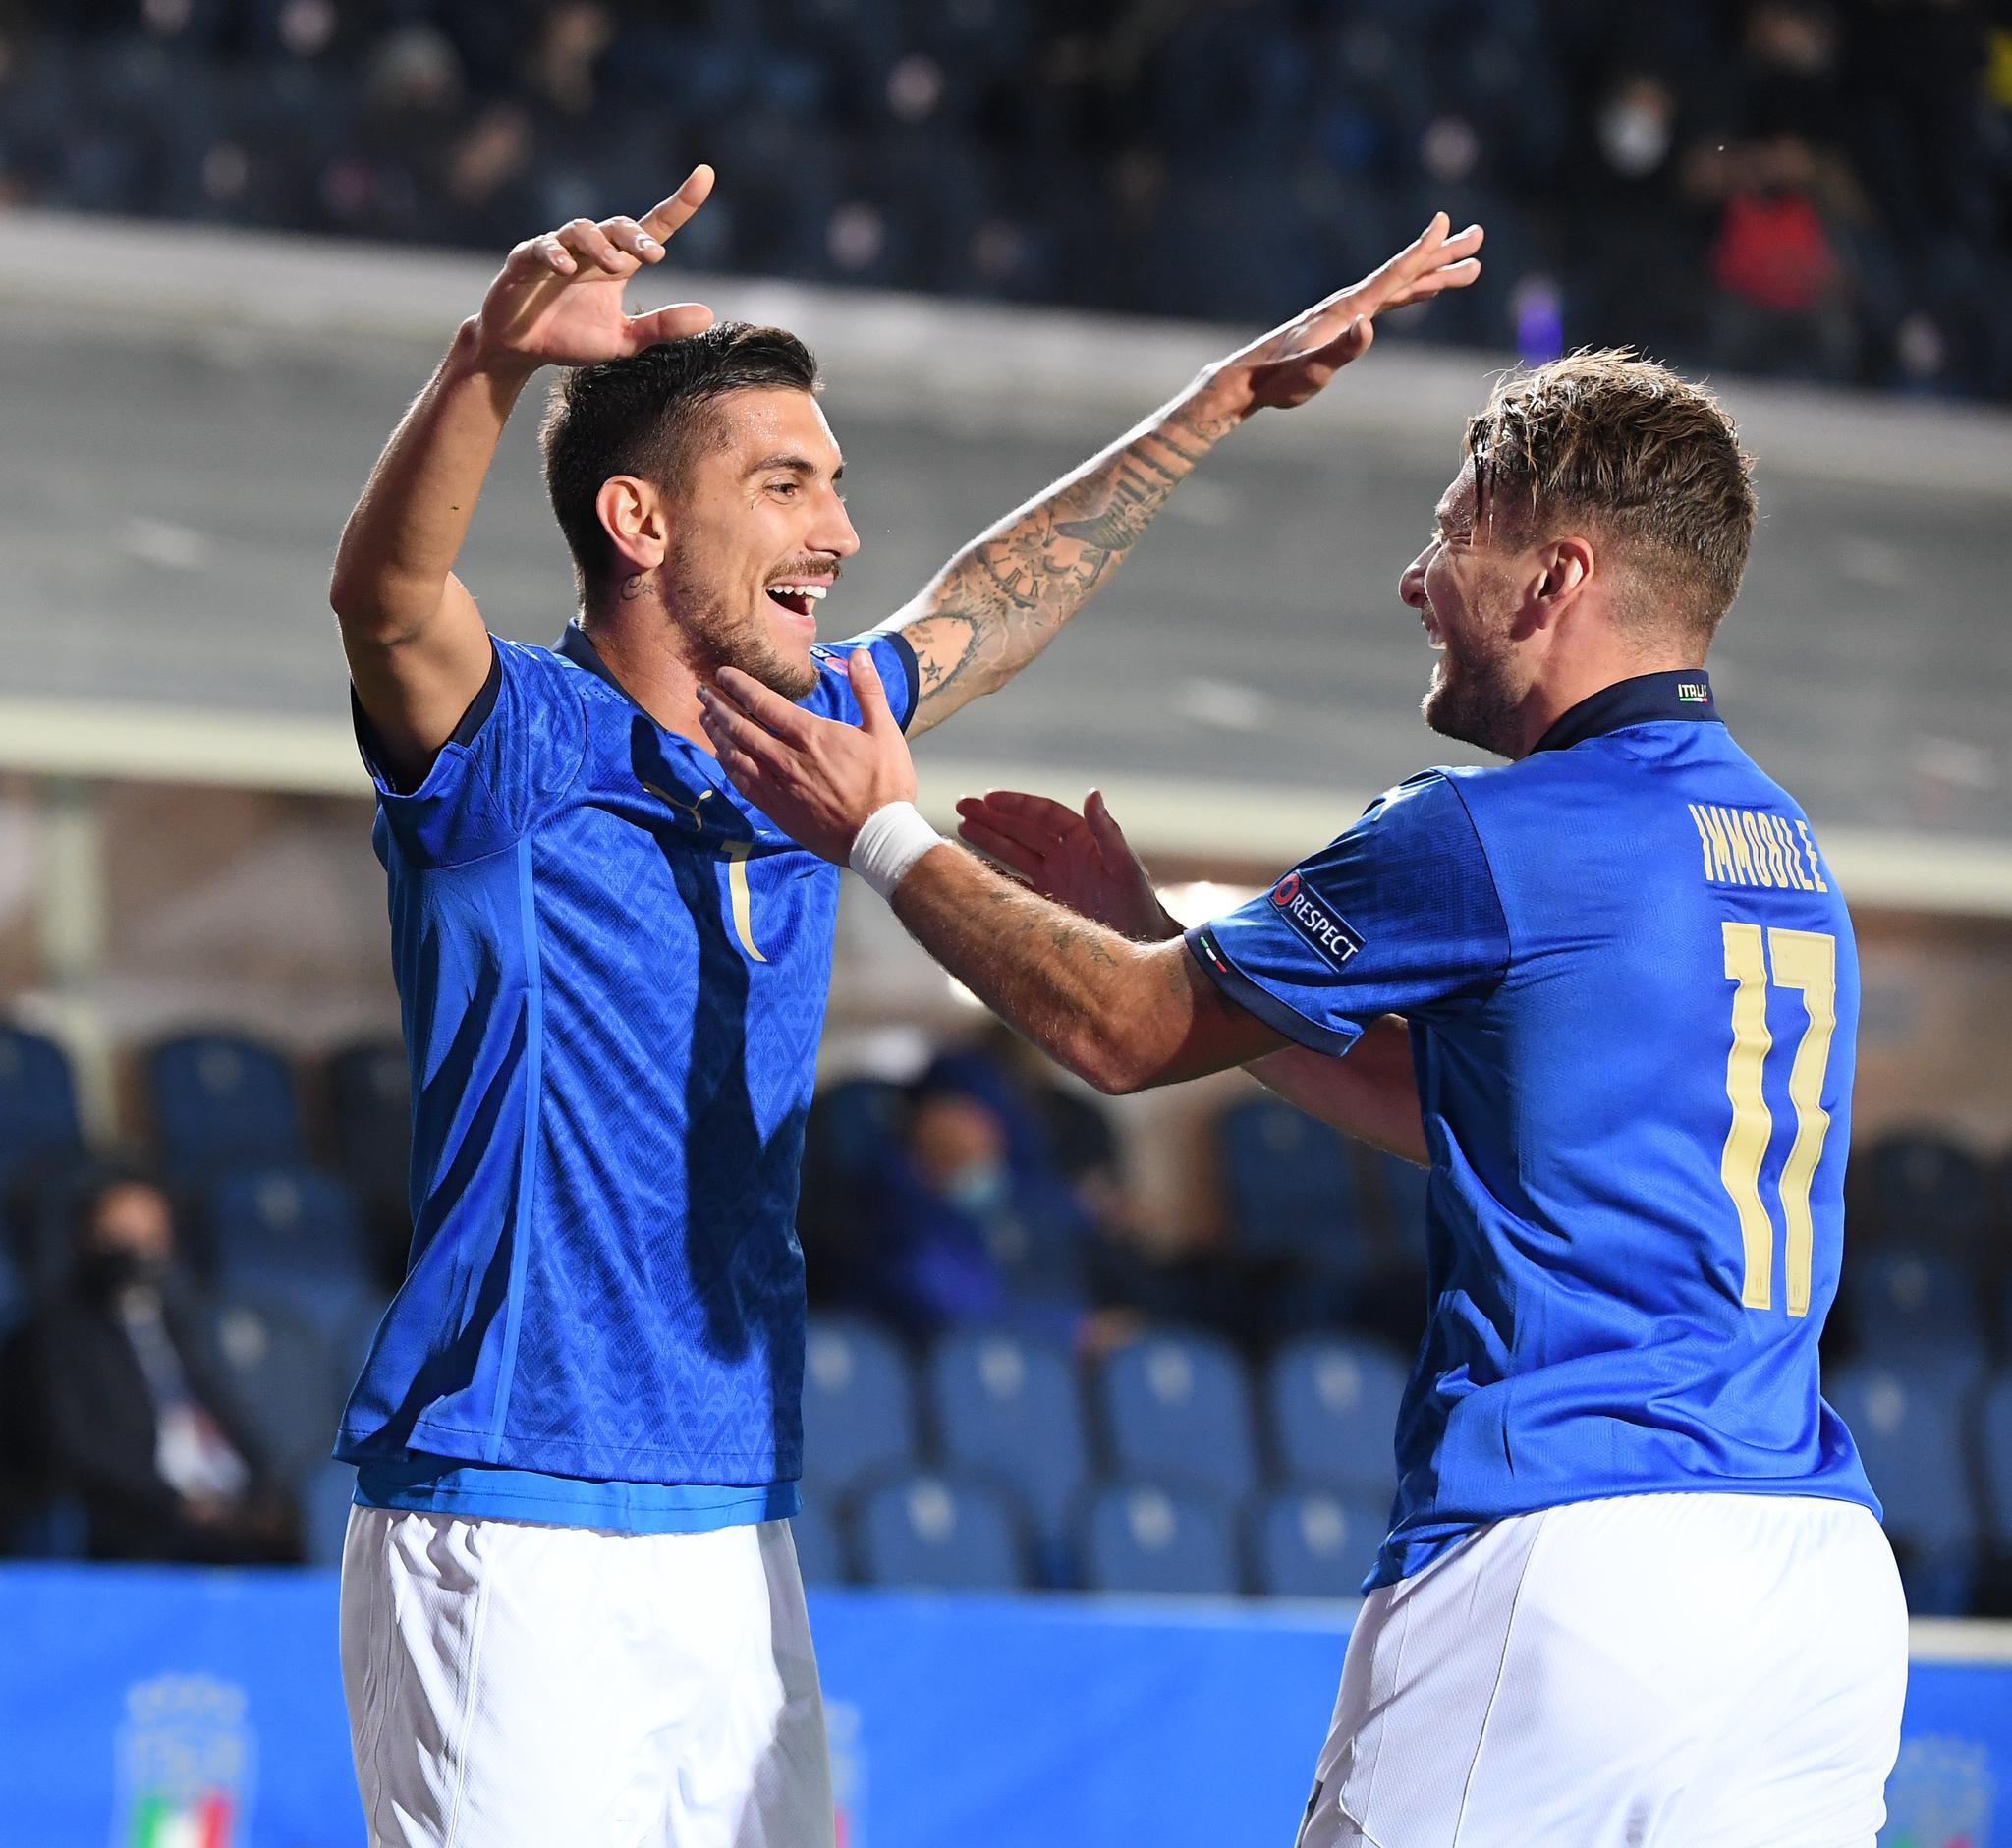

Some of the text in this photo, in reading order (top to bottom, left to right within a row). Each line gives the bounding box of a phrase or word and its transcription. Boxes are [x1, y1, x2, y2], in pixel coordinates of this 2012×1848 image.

[1688, 804, 1828, 892] IMMOBILE
[1289, 893, 1359, 962] RESPECT
[1721, 922, 1836, 1317] 17
